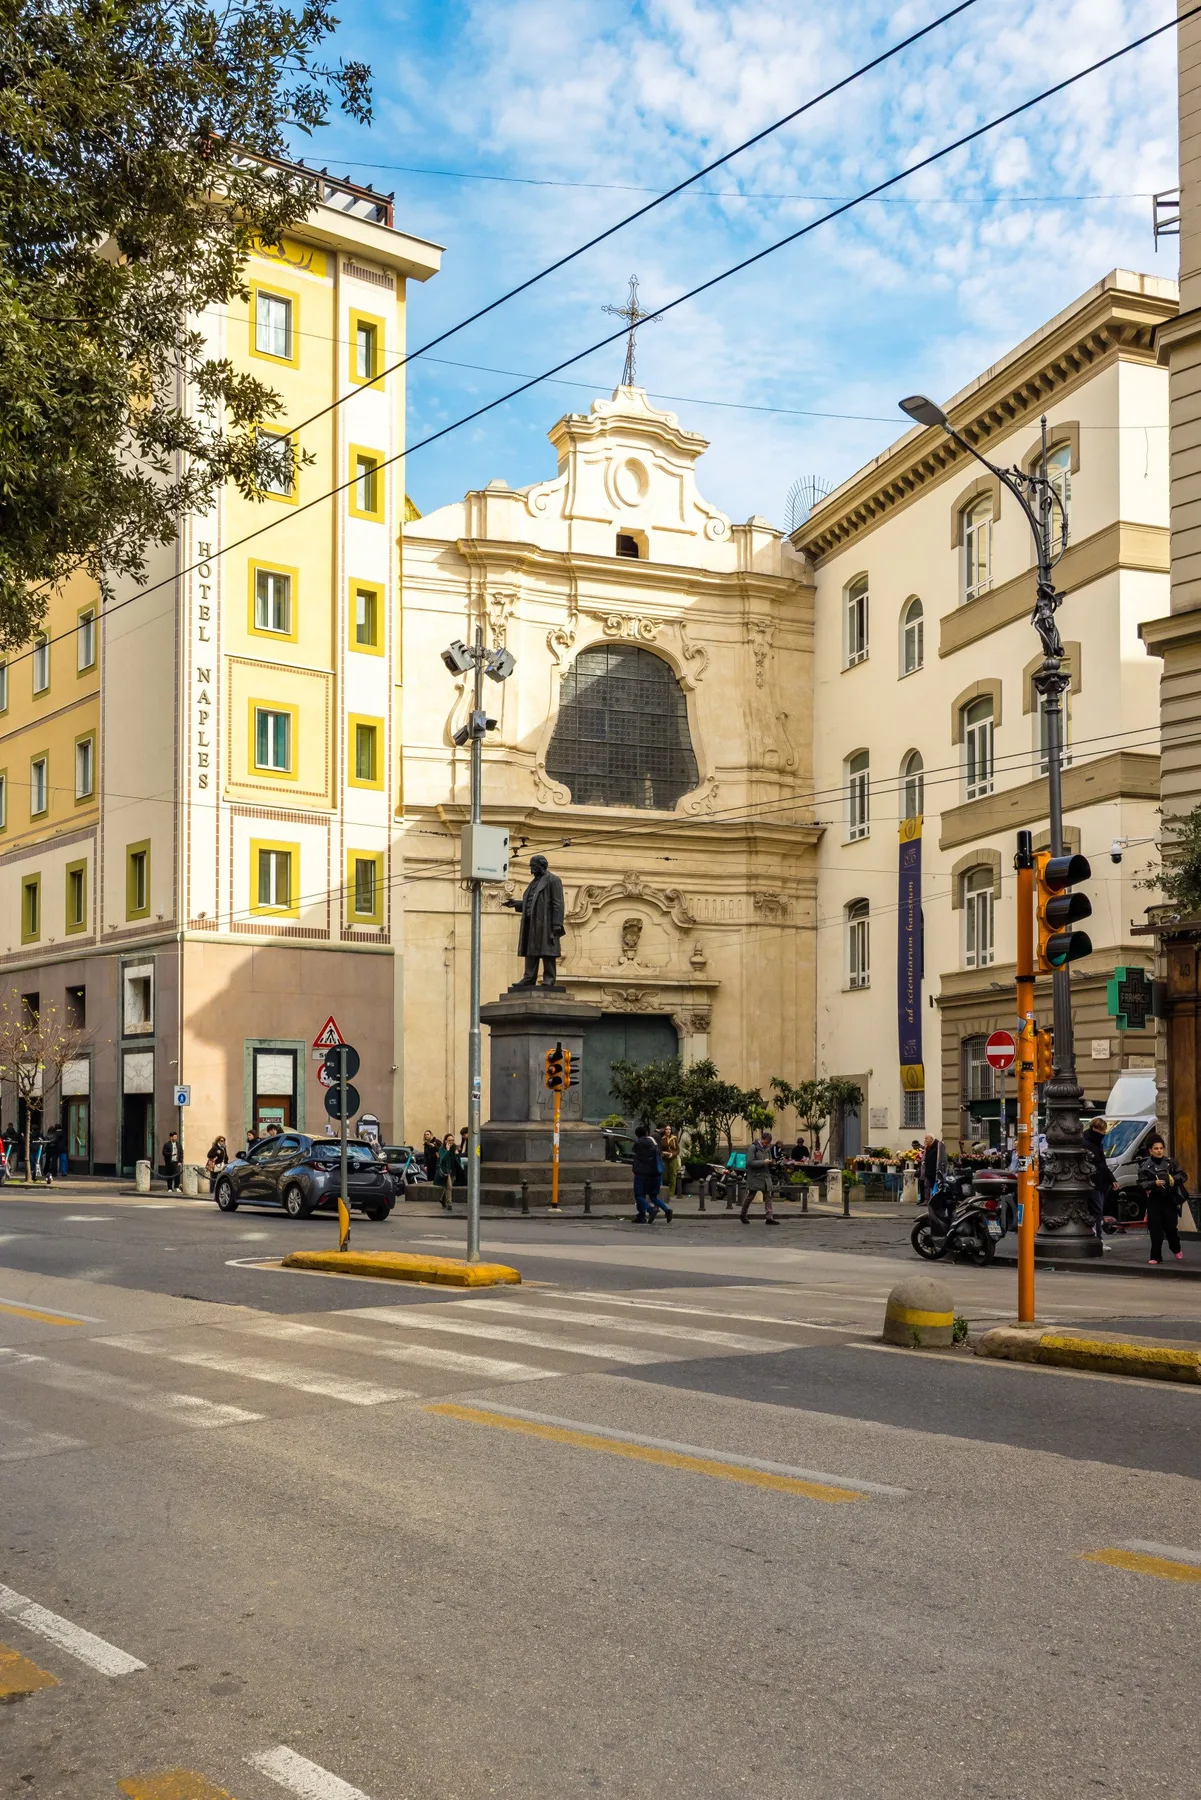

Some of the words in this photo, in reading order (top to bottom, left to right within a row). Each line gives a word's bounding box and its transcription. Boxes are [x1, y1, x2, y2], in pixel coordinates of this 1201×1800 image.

[197, 541, 212, 643] HOTEL
[197, 667, 212, 790] NAPLES
[905, 1007, 914, 1024] ad
